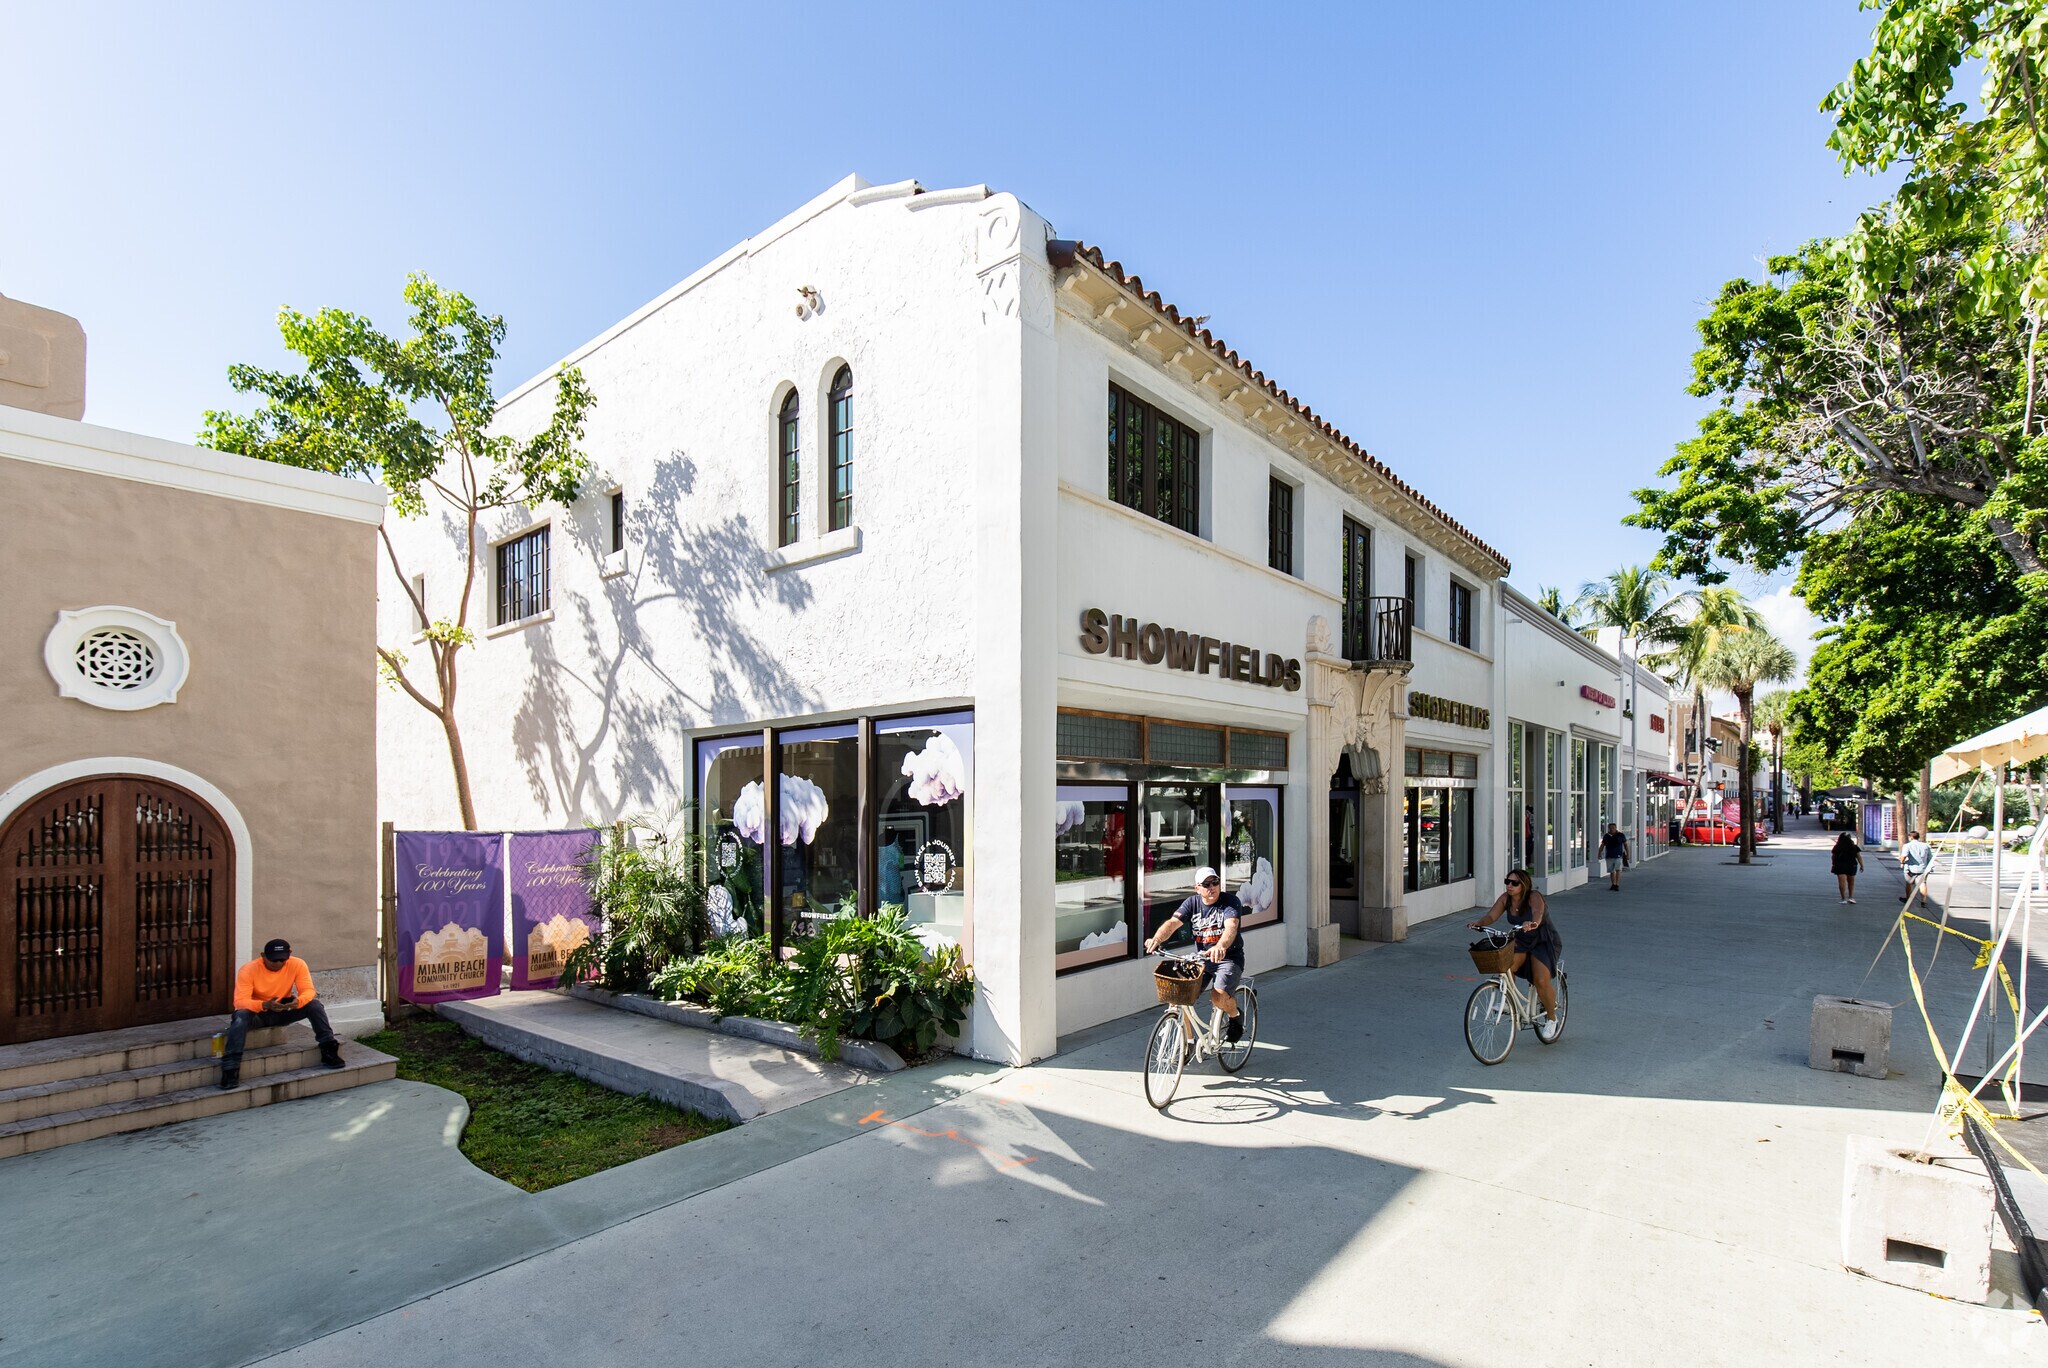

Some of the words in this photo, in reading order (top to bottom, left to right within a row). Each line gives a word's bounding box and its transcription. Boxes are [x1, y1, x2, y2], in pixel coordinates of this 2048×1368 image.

[1080, 608, 1301, 692] SHOWFIELDS
[1408, 691, 1490, 730] SHOWFIELDS
[914, 845, 926, 866] TAKE
[932, 839, 957, 867] JOURNEY
[415, 863, 482, 882] Celebrating
[526, 875, 552, 887] 100
[415, 880, 446, 892] 100
[447, 878, 486, 895] Years
[531, 950, 557, 964] MIAMI
[417, 962, 450, 976] MIAMI
[454, 959, 485, 973] BEACH
[416, 973, 458, 984] COMMUNITY
[459, 970, 485, 980] CHURCH
